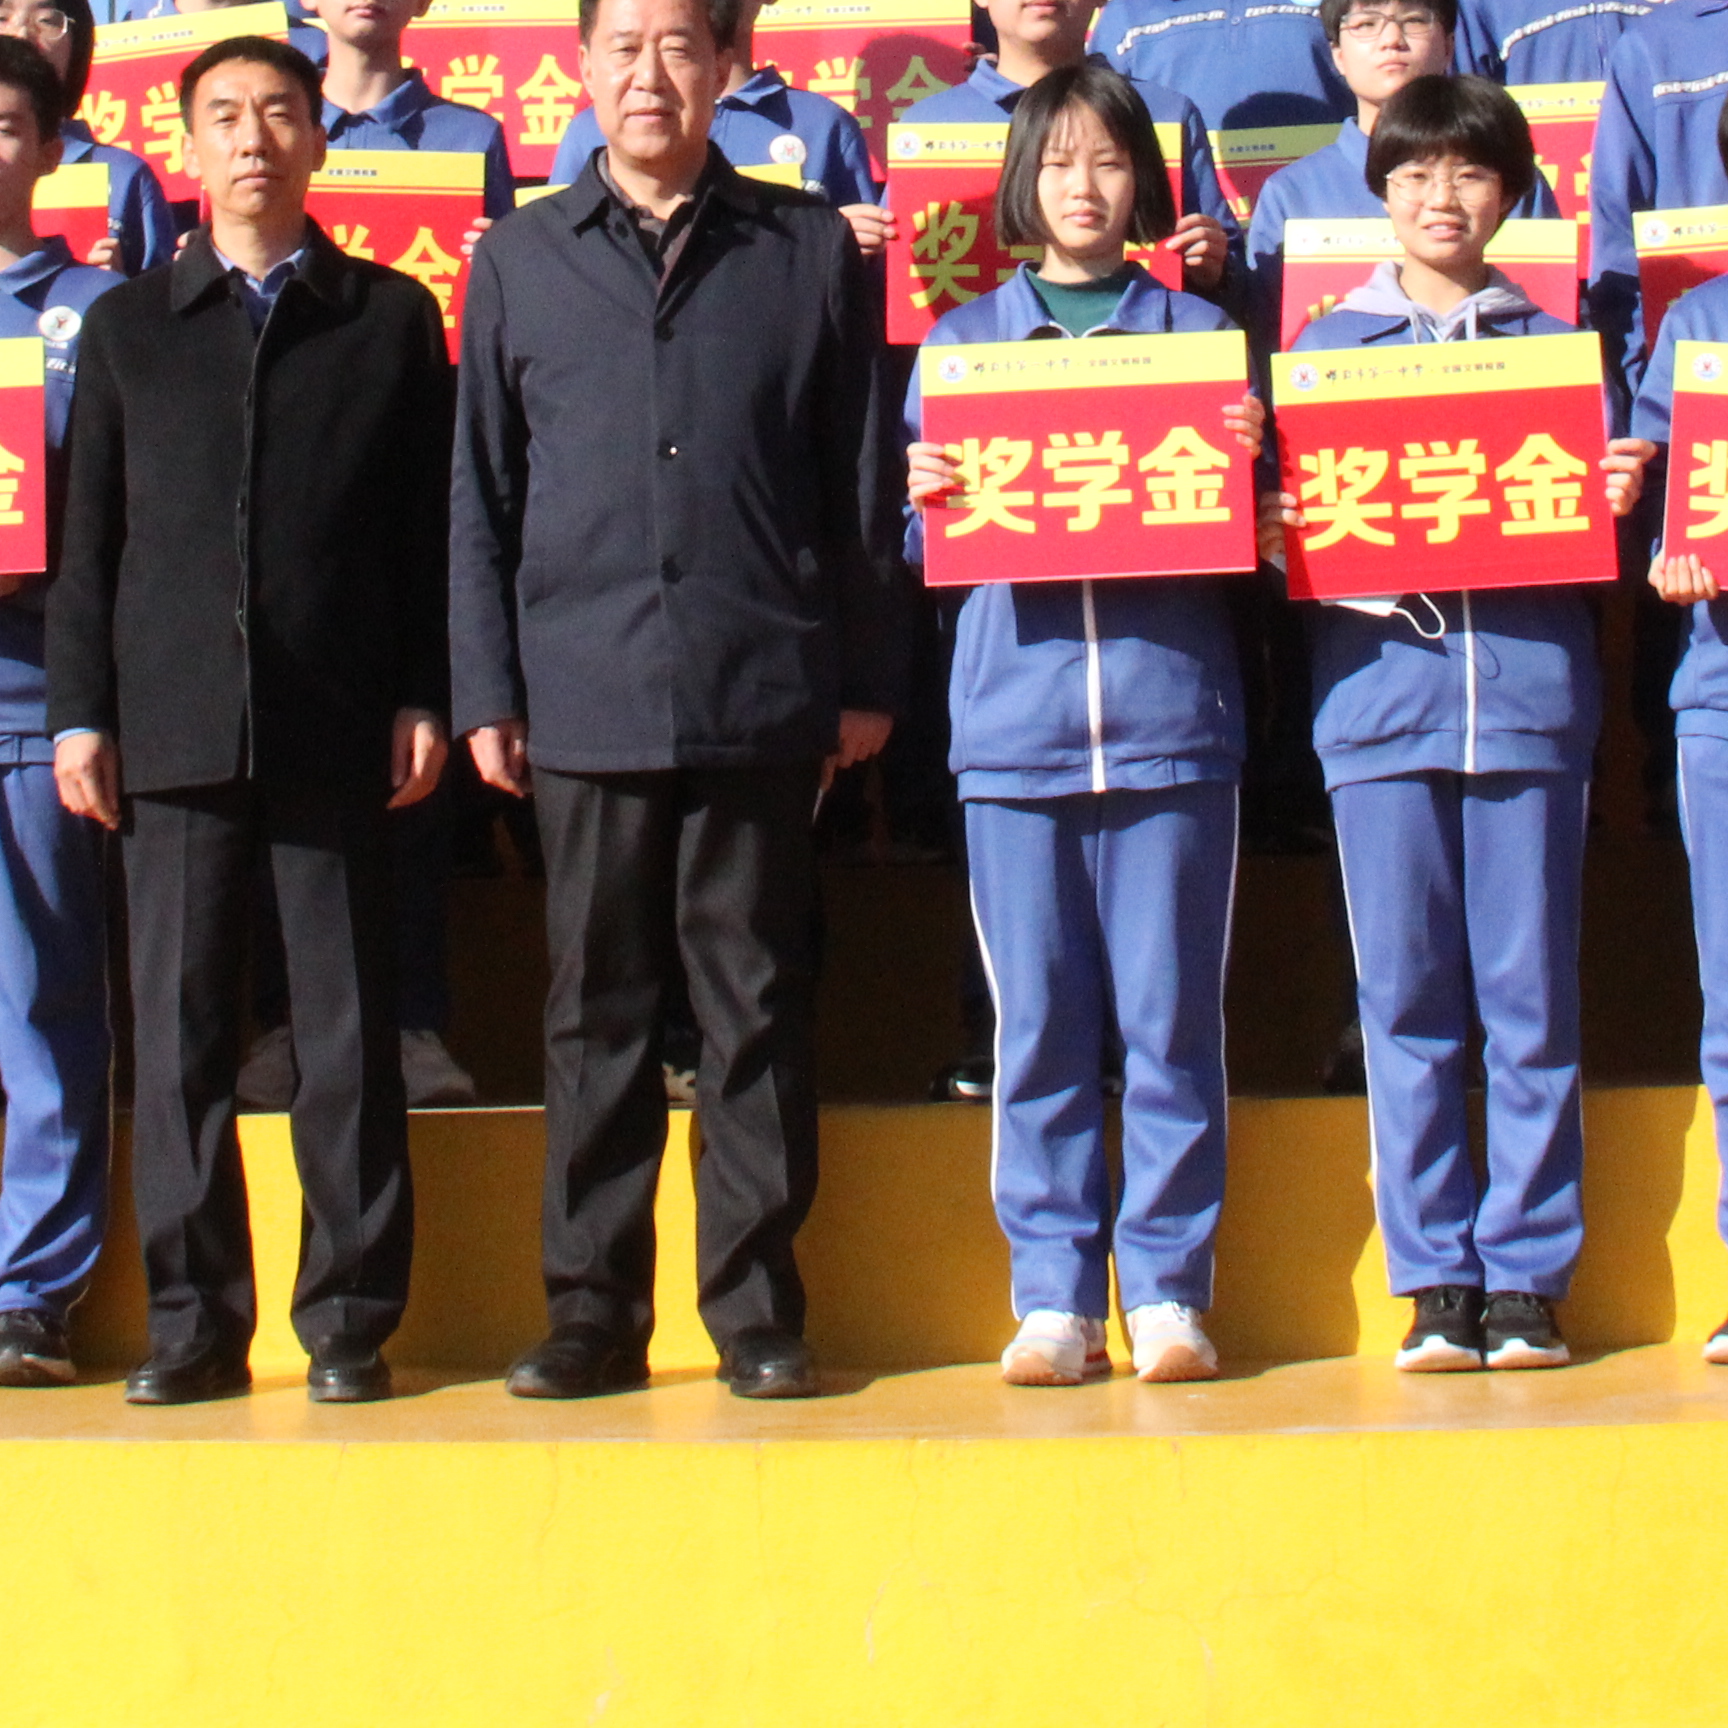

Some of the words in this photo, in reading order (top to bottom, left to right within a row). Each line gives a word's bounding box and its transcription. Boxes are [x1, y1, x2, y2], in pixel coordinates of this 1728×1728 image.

[943, 426, 1231, 538] 奖学金
[1299, 433, 1590, 551] 奖学金
